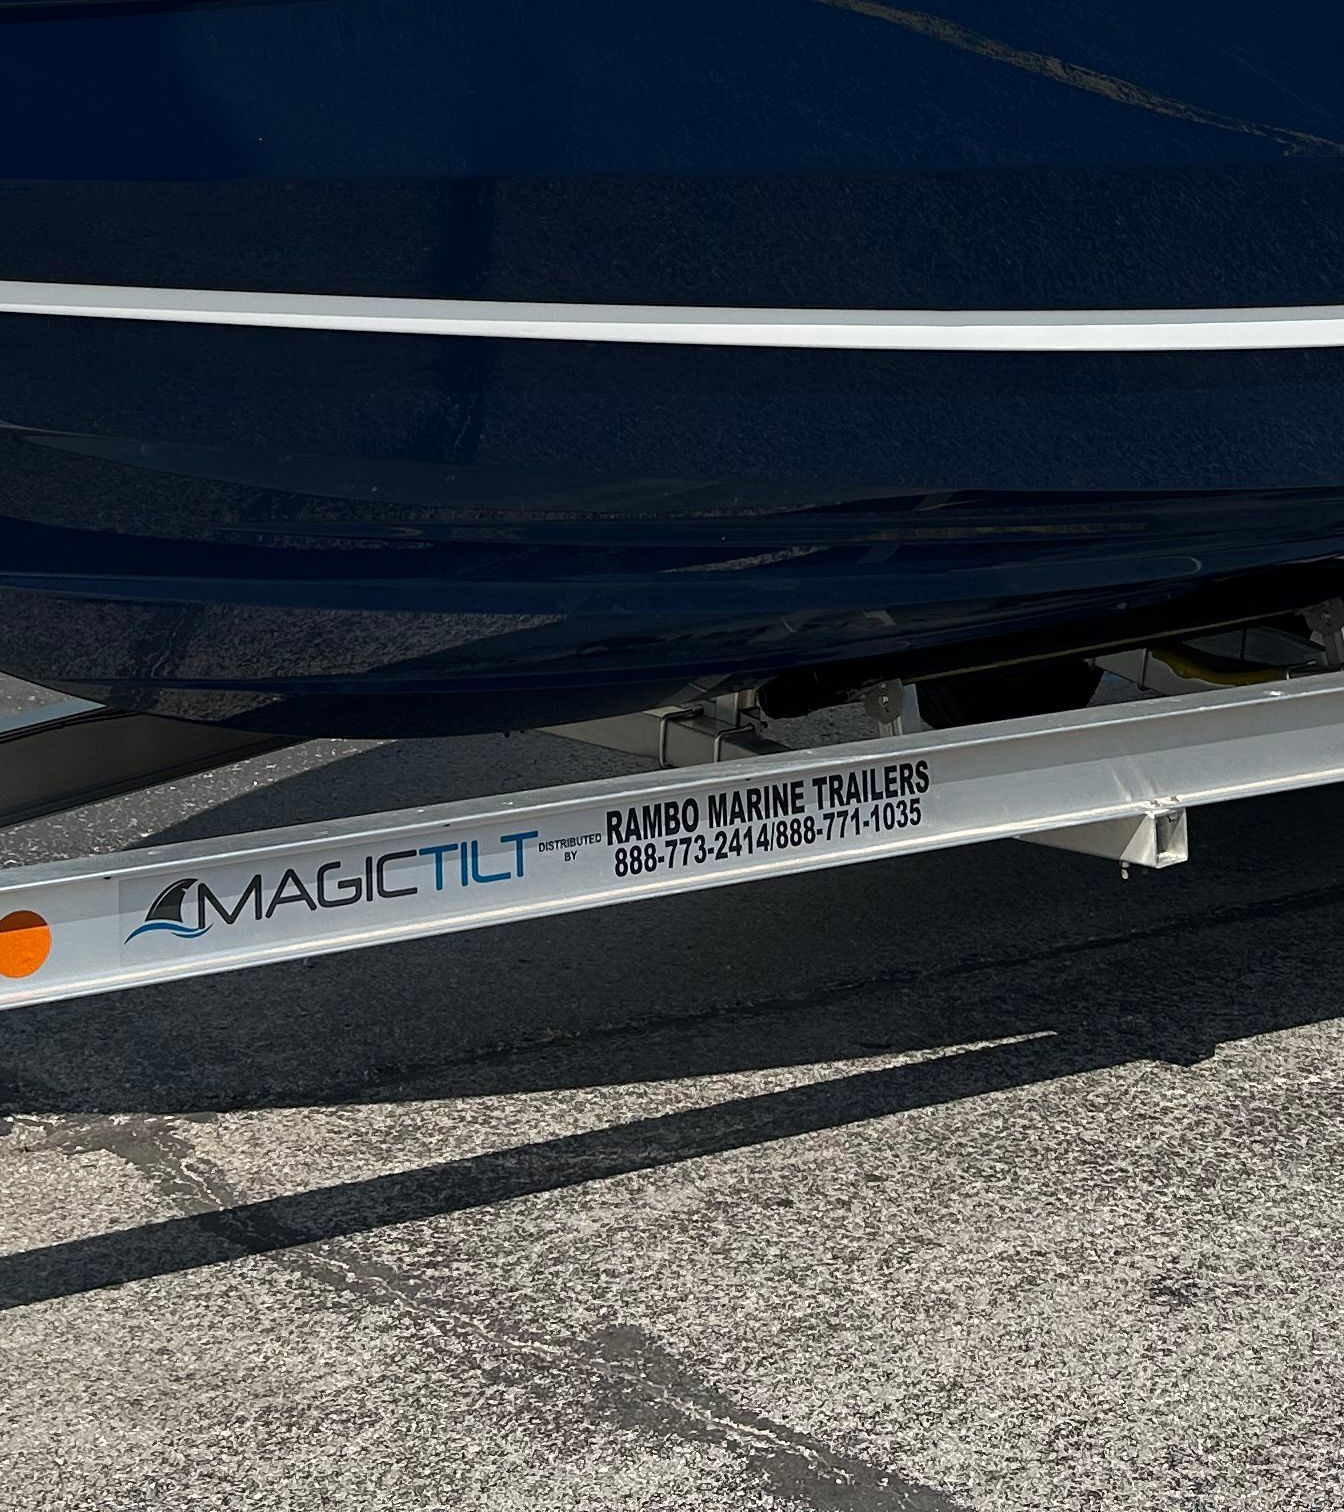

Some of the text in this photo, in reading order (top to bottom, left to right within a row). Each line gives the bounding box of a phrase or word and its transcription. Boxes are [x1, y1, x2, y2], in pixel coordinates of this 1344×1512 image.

[606, 759, 931, 846] RAMBO MARINE TRAILERS
[538, 833, 602, 853] DISTRIBUTED
[564, 850, 578, 862] BY
[197, 830, 539, 930] MAGICTILT
